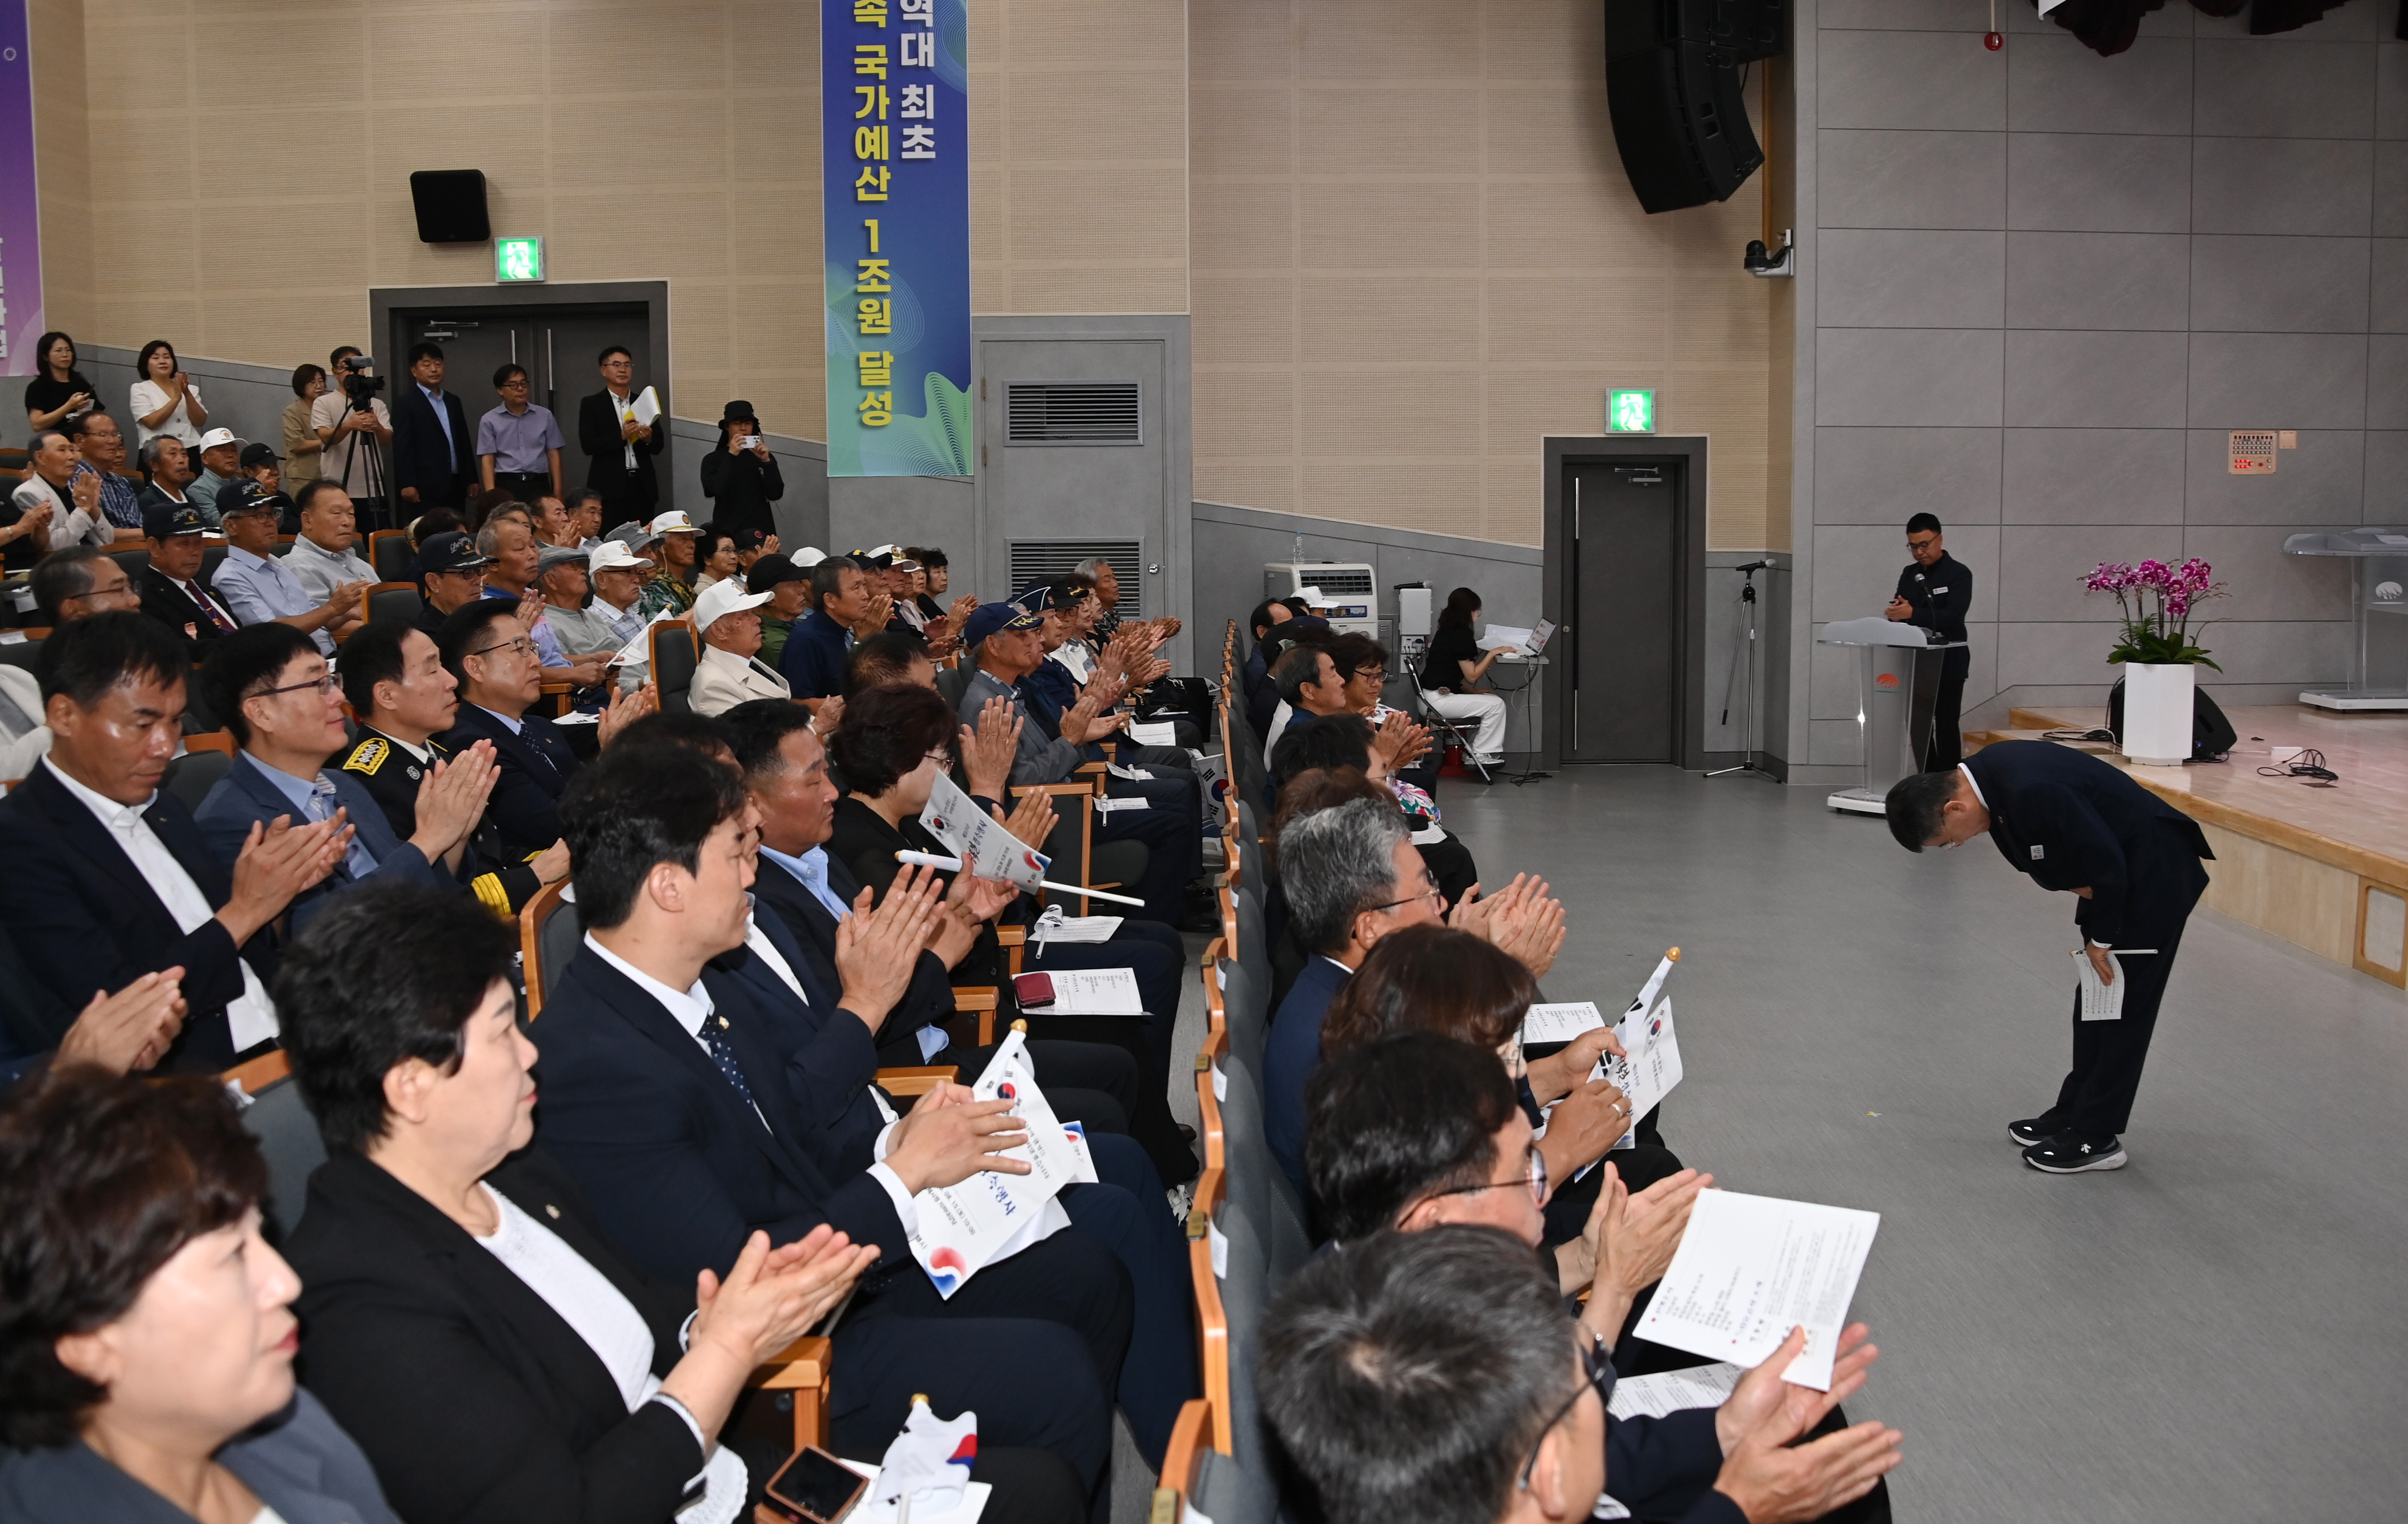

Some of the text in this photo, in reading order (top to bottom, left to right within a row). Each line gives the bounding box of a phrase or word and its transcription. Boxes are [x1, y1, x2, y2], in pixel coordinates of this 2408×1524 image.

[854, 45, 891, 201] 국가예산
[900, 0, 936, 159] 역대 최초
[857, 219, 892, 334] 1조원
[859, 351, 894, 426] 달성
[967, 841, 980, 865] 복절
[980, 1170, 1016, 1216] 축행사
